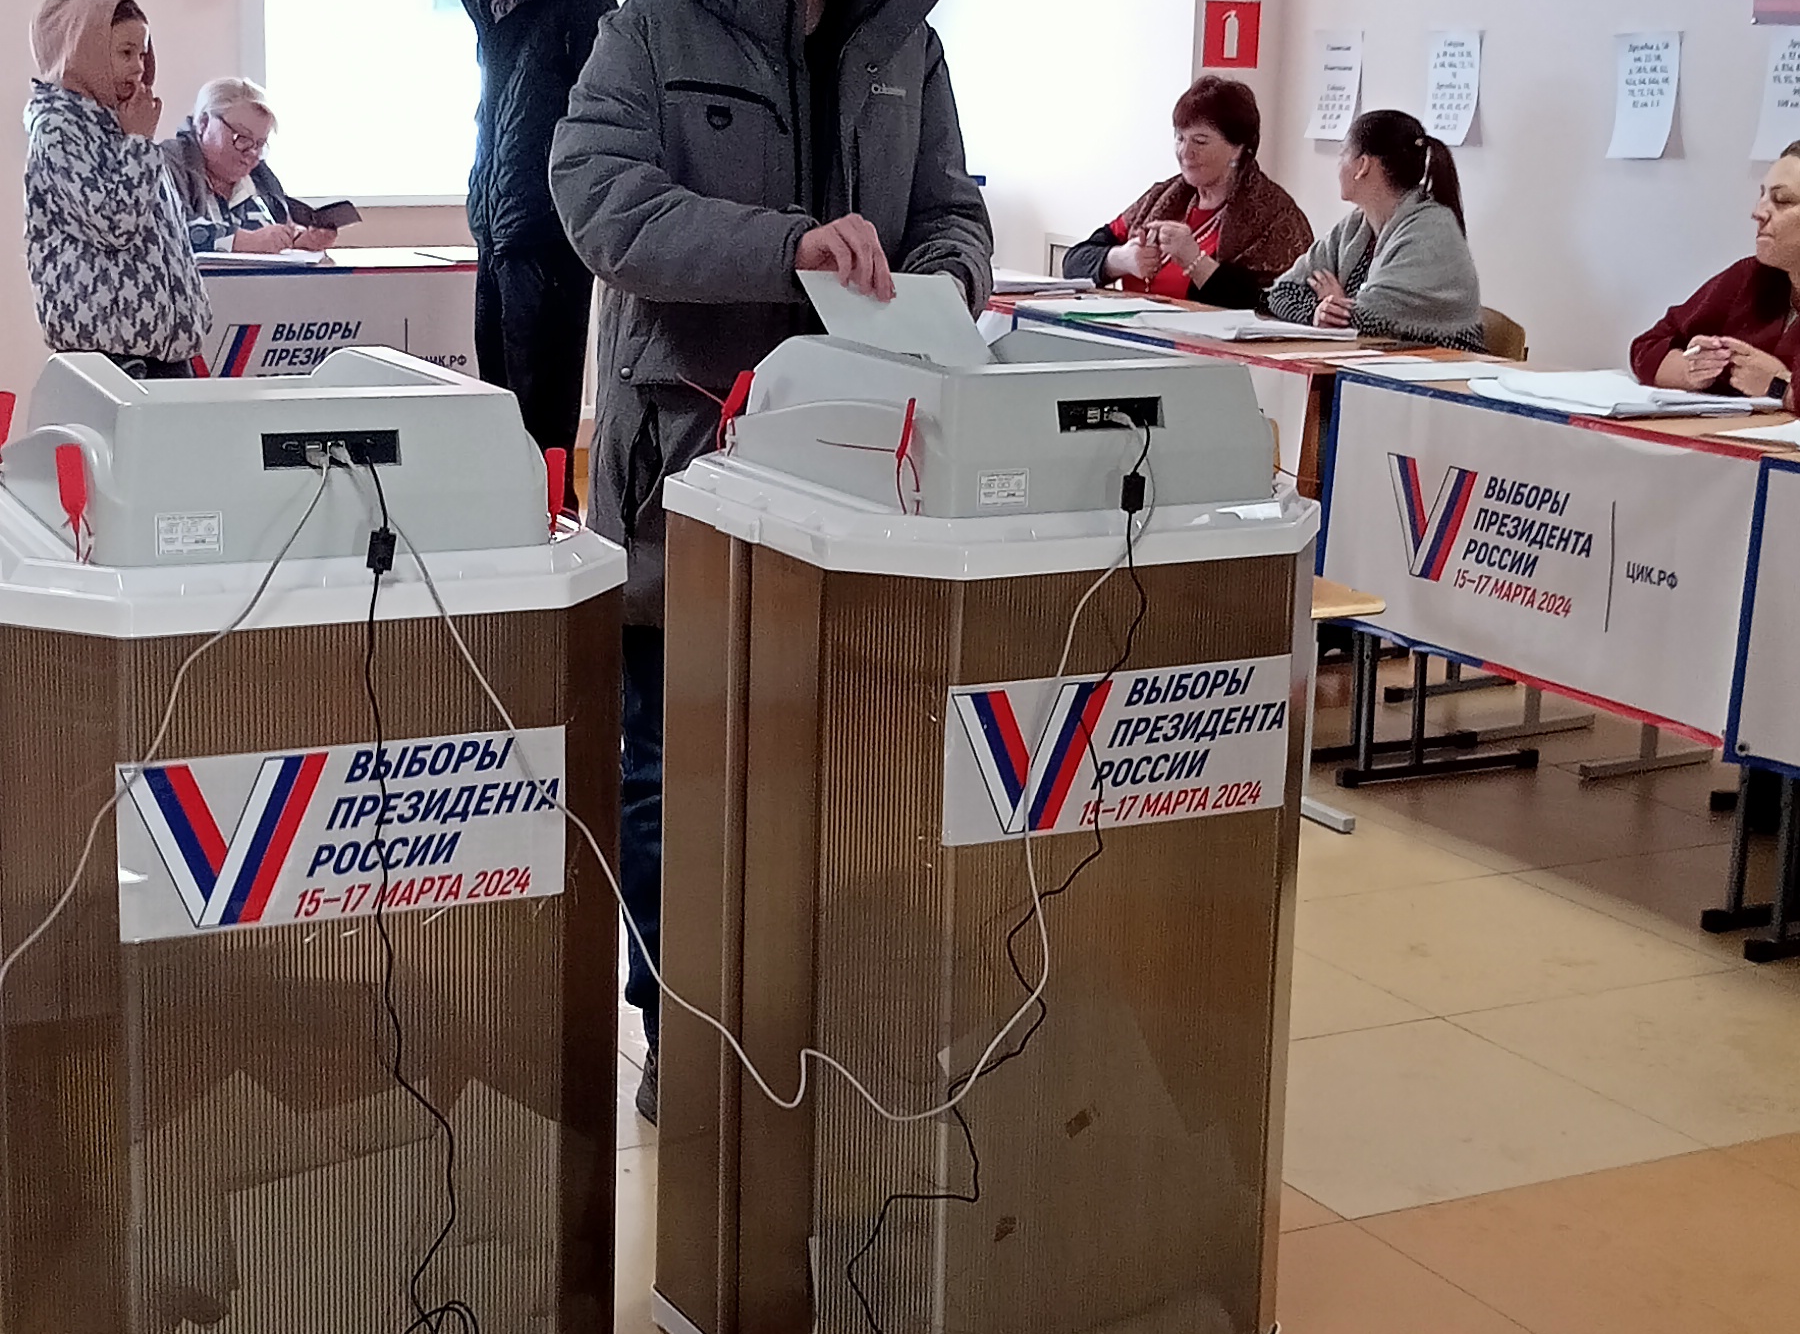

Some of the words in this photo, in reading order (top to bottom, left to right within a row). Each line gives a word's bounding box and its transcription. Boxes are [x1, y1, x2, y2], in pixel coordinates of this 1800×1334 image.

[271, 321, 362, 342] ВЫБОРЫ
[261, 347, 343, 367] ПРЕЗИ
[419, 354, 467, 368] ИК.РФ
[1484, 476, 1570, 517] ВЫБОРЫ
[1473, 508, 1594, 559] ПРЕЗИДЕНТА
[1462, 538, 1539, 579] РОССИИ
[1626, 561, 1679, 590] ЦИК.РФ
[1491, 579, 1536, 609] МАРТА
[1537, 593, 1572, 618] 2024
[1125, 666, 1255, 708] ВЫБОРЫ
[1107, 701, 1287, 749] ПРЕЗИДЕНТА
[344, 737, 515, 784] ВЫБОРЫ
[1091, 749, 1211, 790] РОССИИ
[326, 778, 560, 831] ПРЕЗИДЕНТА
[1141, 786, 1210, 815] МАРТА
[1212, 780, 1261, 809] 2024
[307, 832, 461, 878] РОССИИ
[372, 872, 461, 909] МАРТА
[467, 867, 531, 899] 2024
